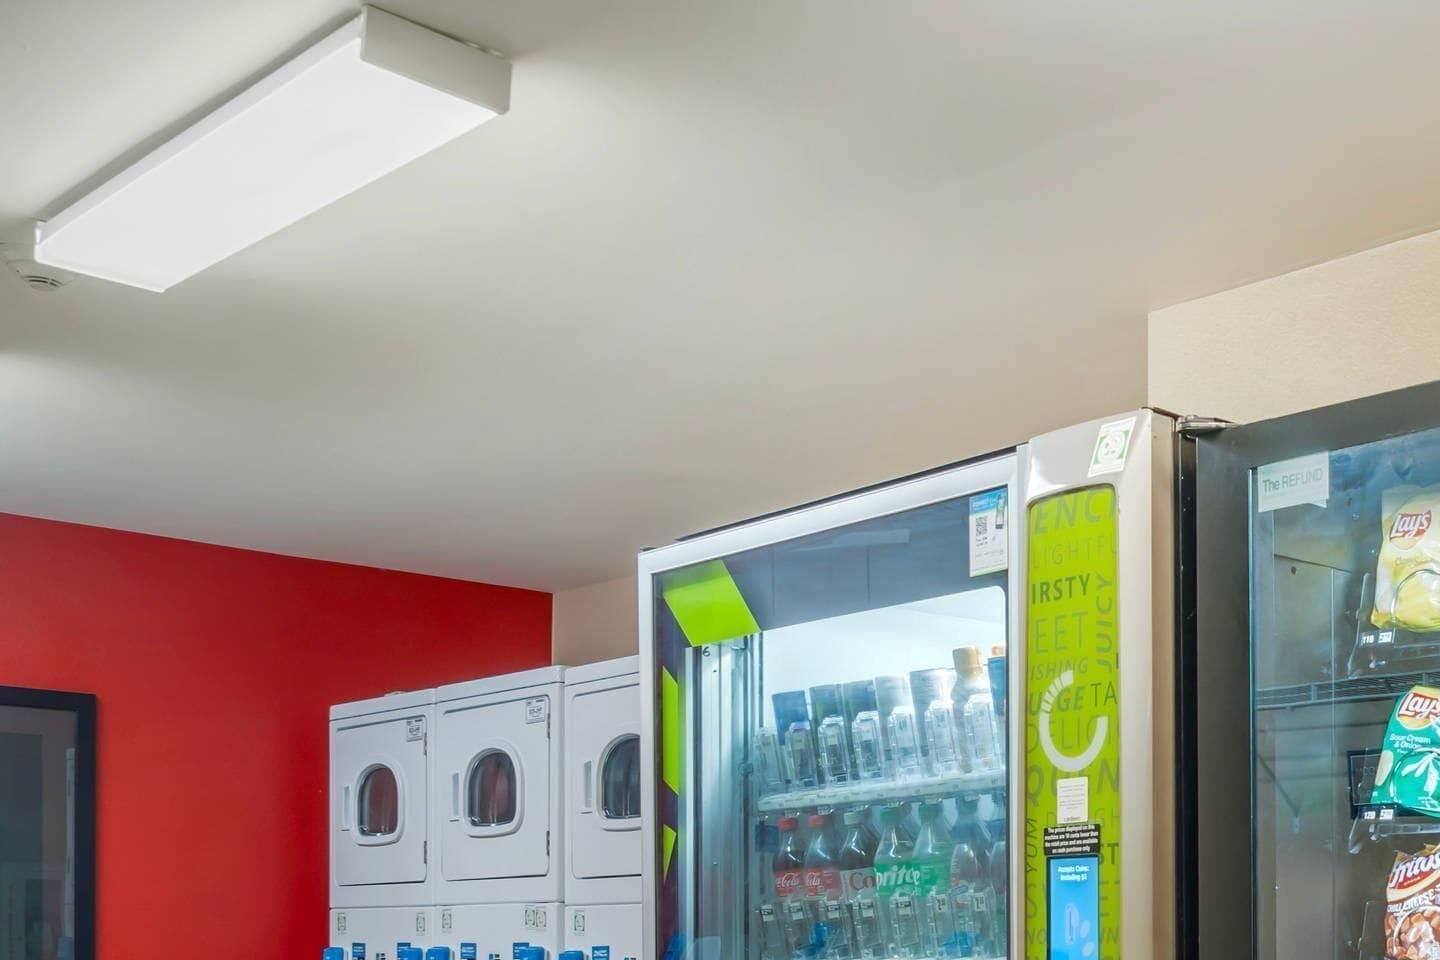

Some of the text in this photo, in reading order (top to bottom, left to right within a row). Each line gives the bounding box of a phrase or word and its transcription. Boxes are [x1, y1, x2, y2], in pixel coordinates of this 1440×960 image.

[1264, 467, 1323, 493] The REFUND
[1390, 510, 1431, 538] Lay's
[1096, 571, 1113, 673] JUICY
